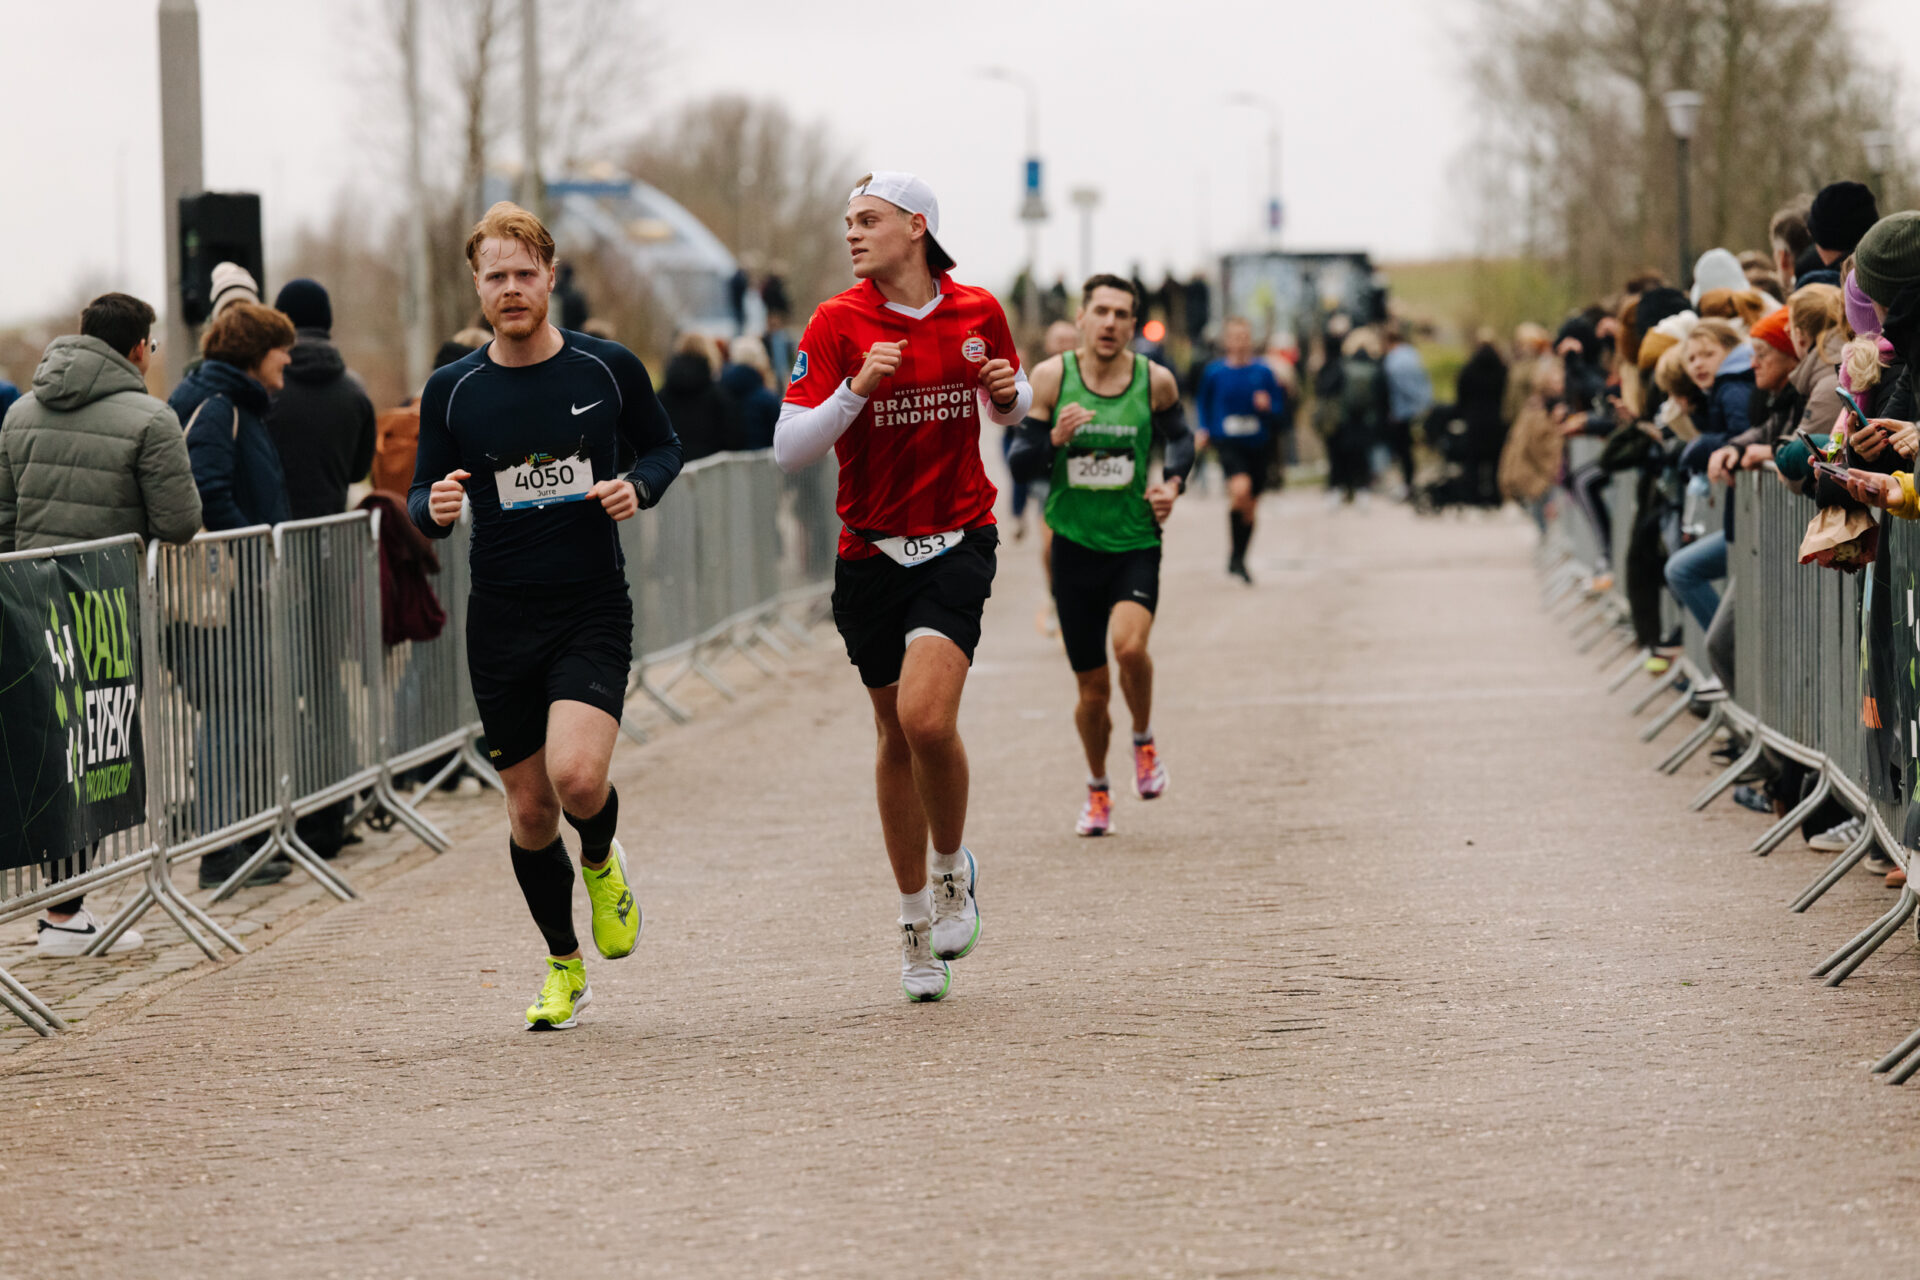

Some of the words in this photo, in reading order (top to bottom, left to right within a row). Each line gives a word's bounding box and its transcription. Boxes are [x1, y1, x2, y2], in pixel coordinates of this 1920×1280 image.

[895, 382, 964, 396] METROPOOLREGIO
[874, 404, 974, 428] EINDHOVE
[515, 465, 575, 490] 4050
[1078, 461, 1123, 477] 2094
[68, 587, 134, 681] VALK
[85, 684, 136, 765] EVENT
[86, 762, 132, 804] PRODUCTIONS
